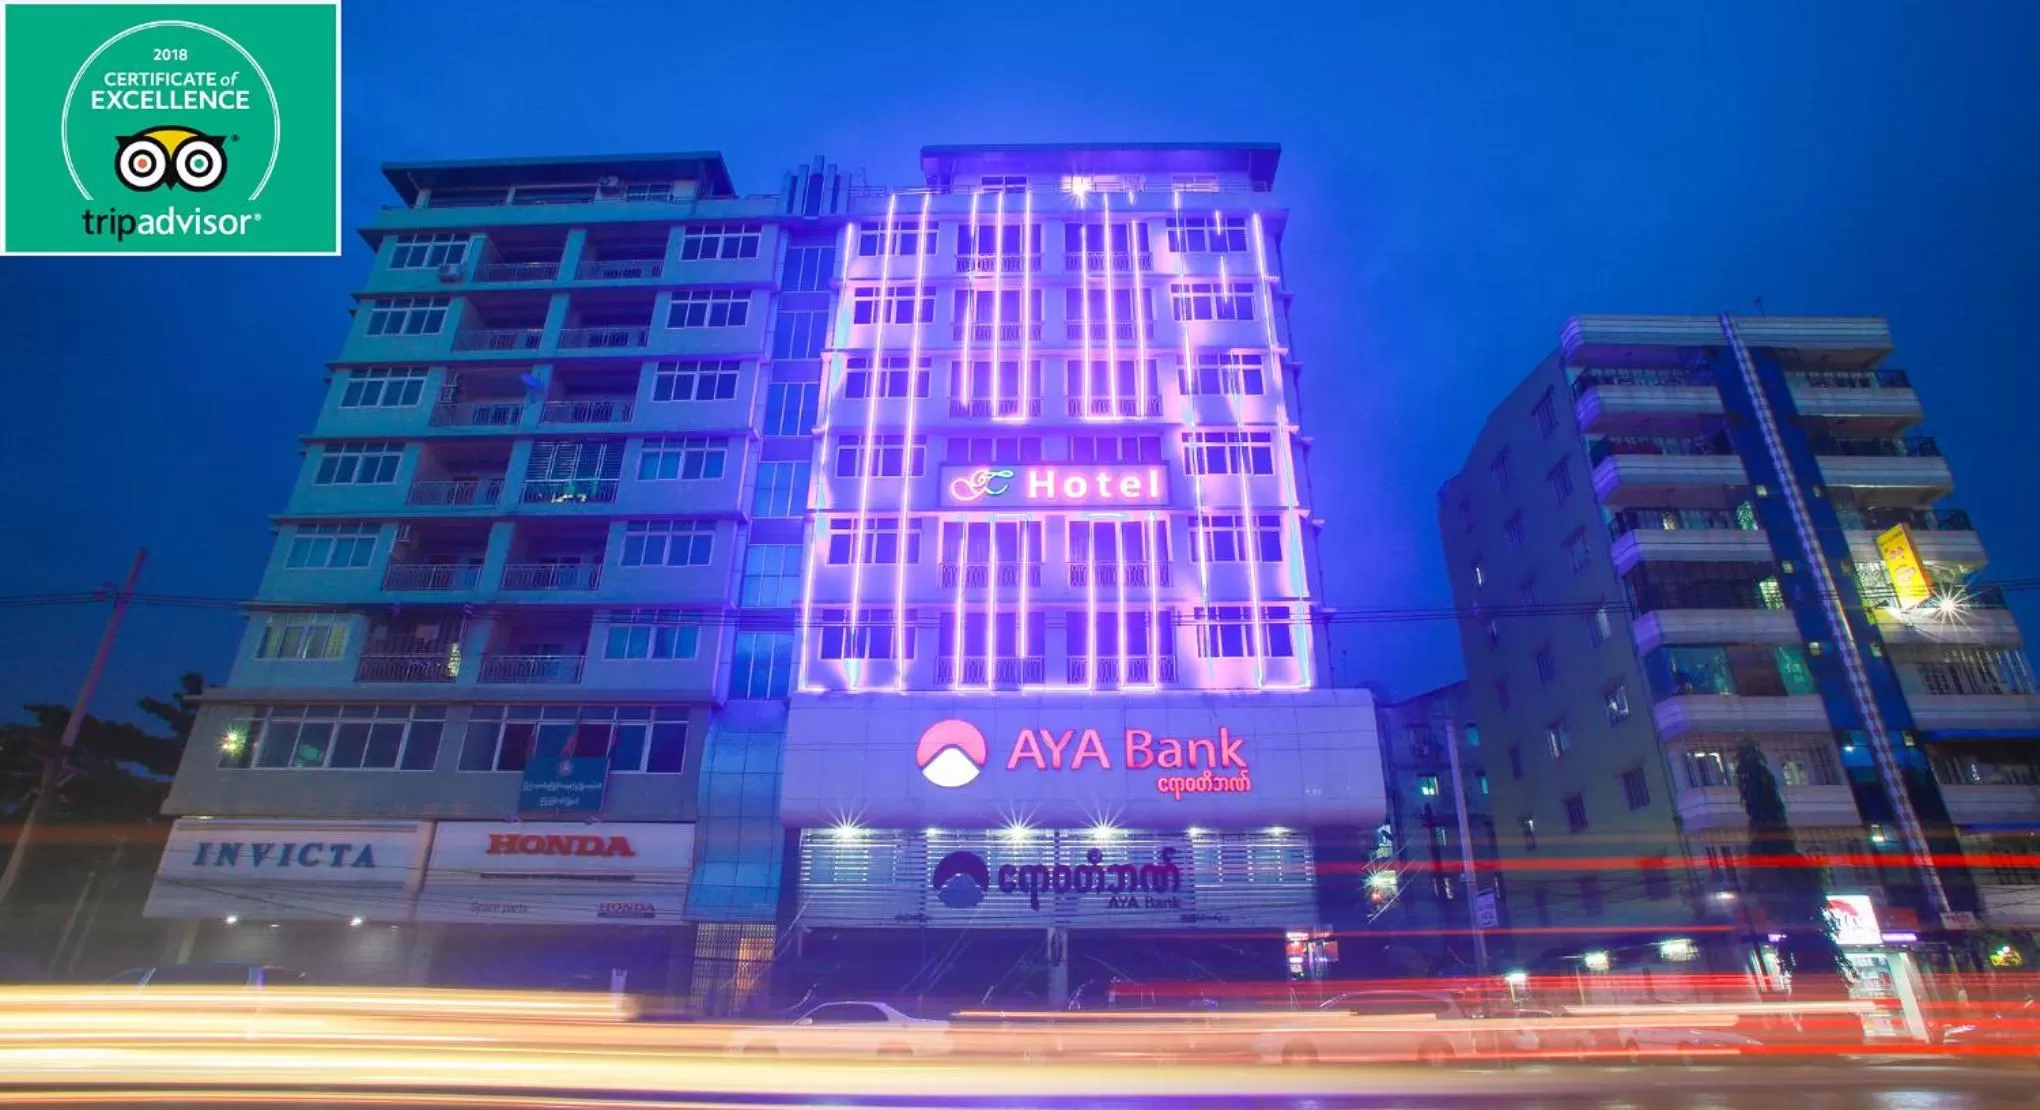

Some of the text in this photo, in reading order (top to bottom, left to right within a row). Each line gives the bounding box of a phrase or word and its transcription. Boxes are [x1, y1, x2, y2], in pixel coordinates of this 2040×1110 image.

[1027, 469, 1160, 499] Hotel
[1006, 726, 1247, 771] AYA Bank
[193, 841, 377, 868] INVICTA
[486, 834, 636, 857] HONDA
[598, 903, 656, 913] HONDA
[1108, 896, 1182, 909] AYA Bank
